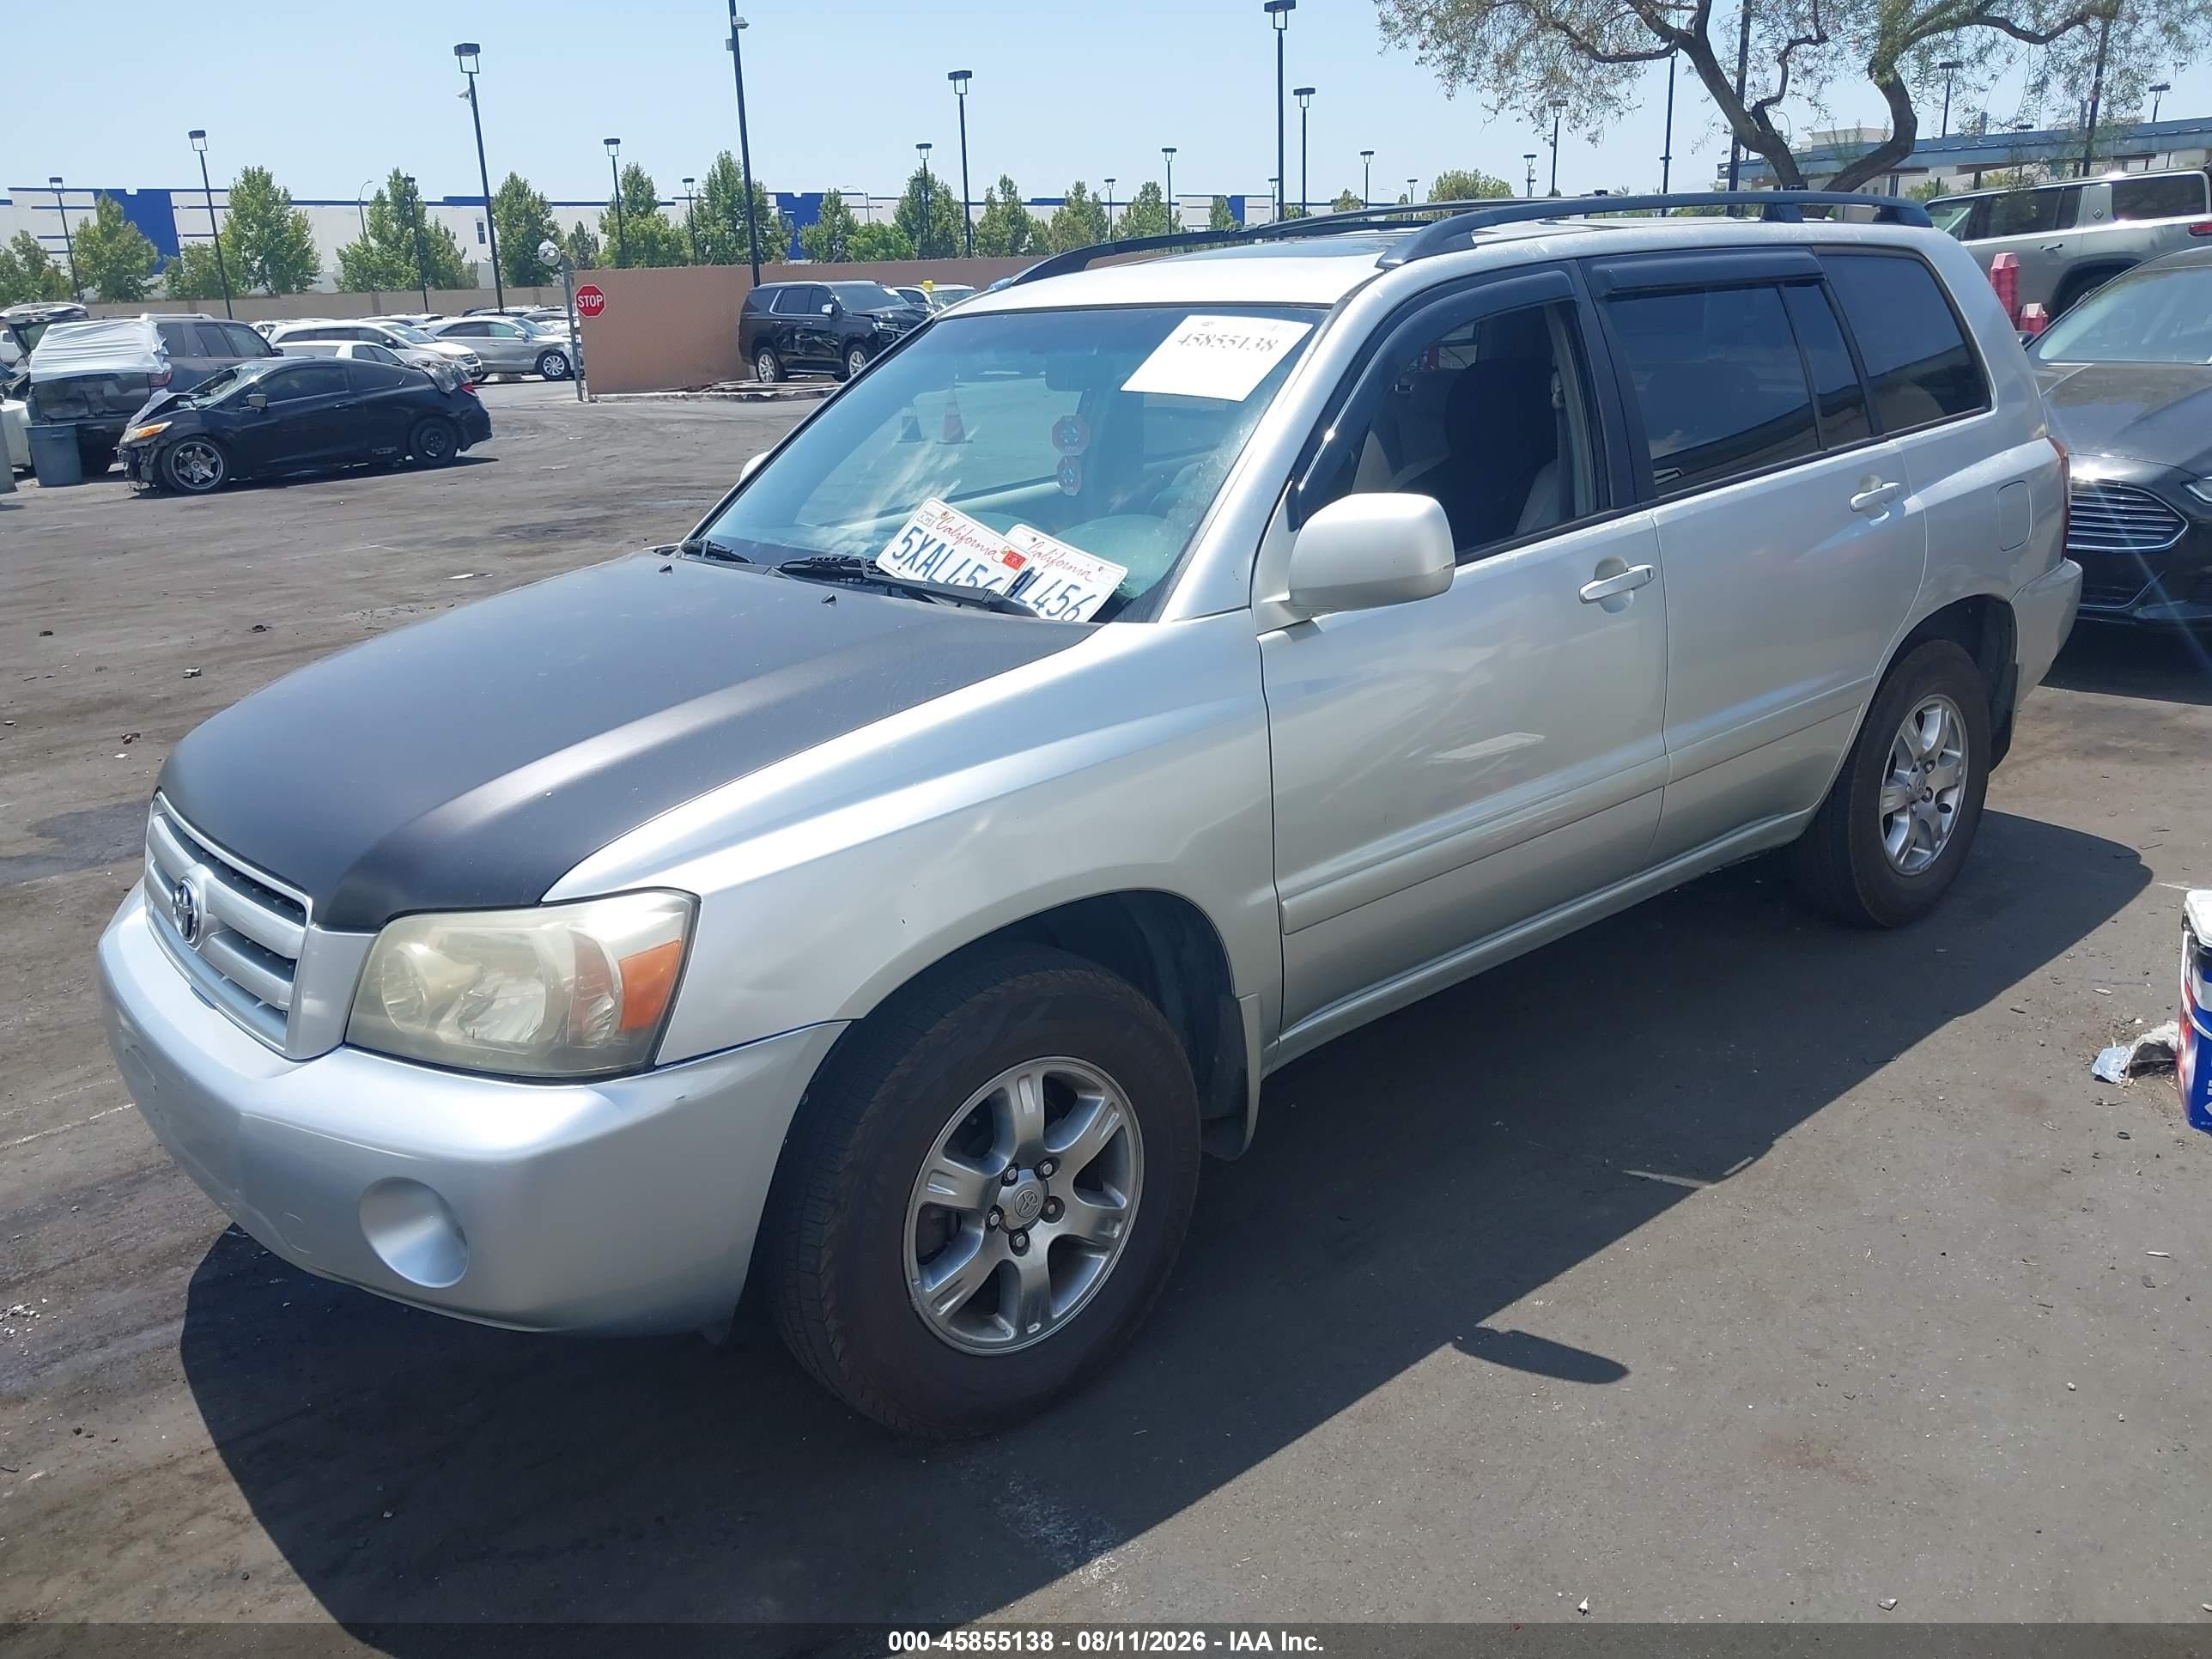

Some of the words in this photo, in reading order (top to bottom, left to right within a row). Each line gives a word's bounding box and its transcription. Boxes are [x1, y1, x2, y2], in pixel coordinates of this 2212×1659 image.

[577, 295, 603, 307] STOP
[936, 515, 1000, 563] California
[1027, 541, 1093, 582] California
